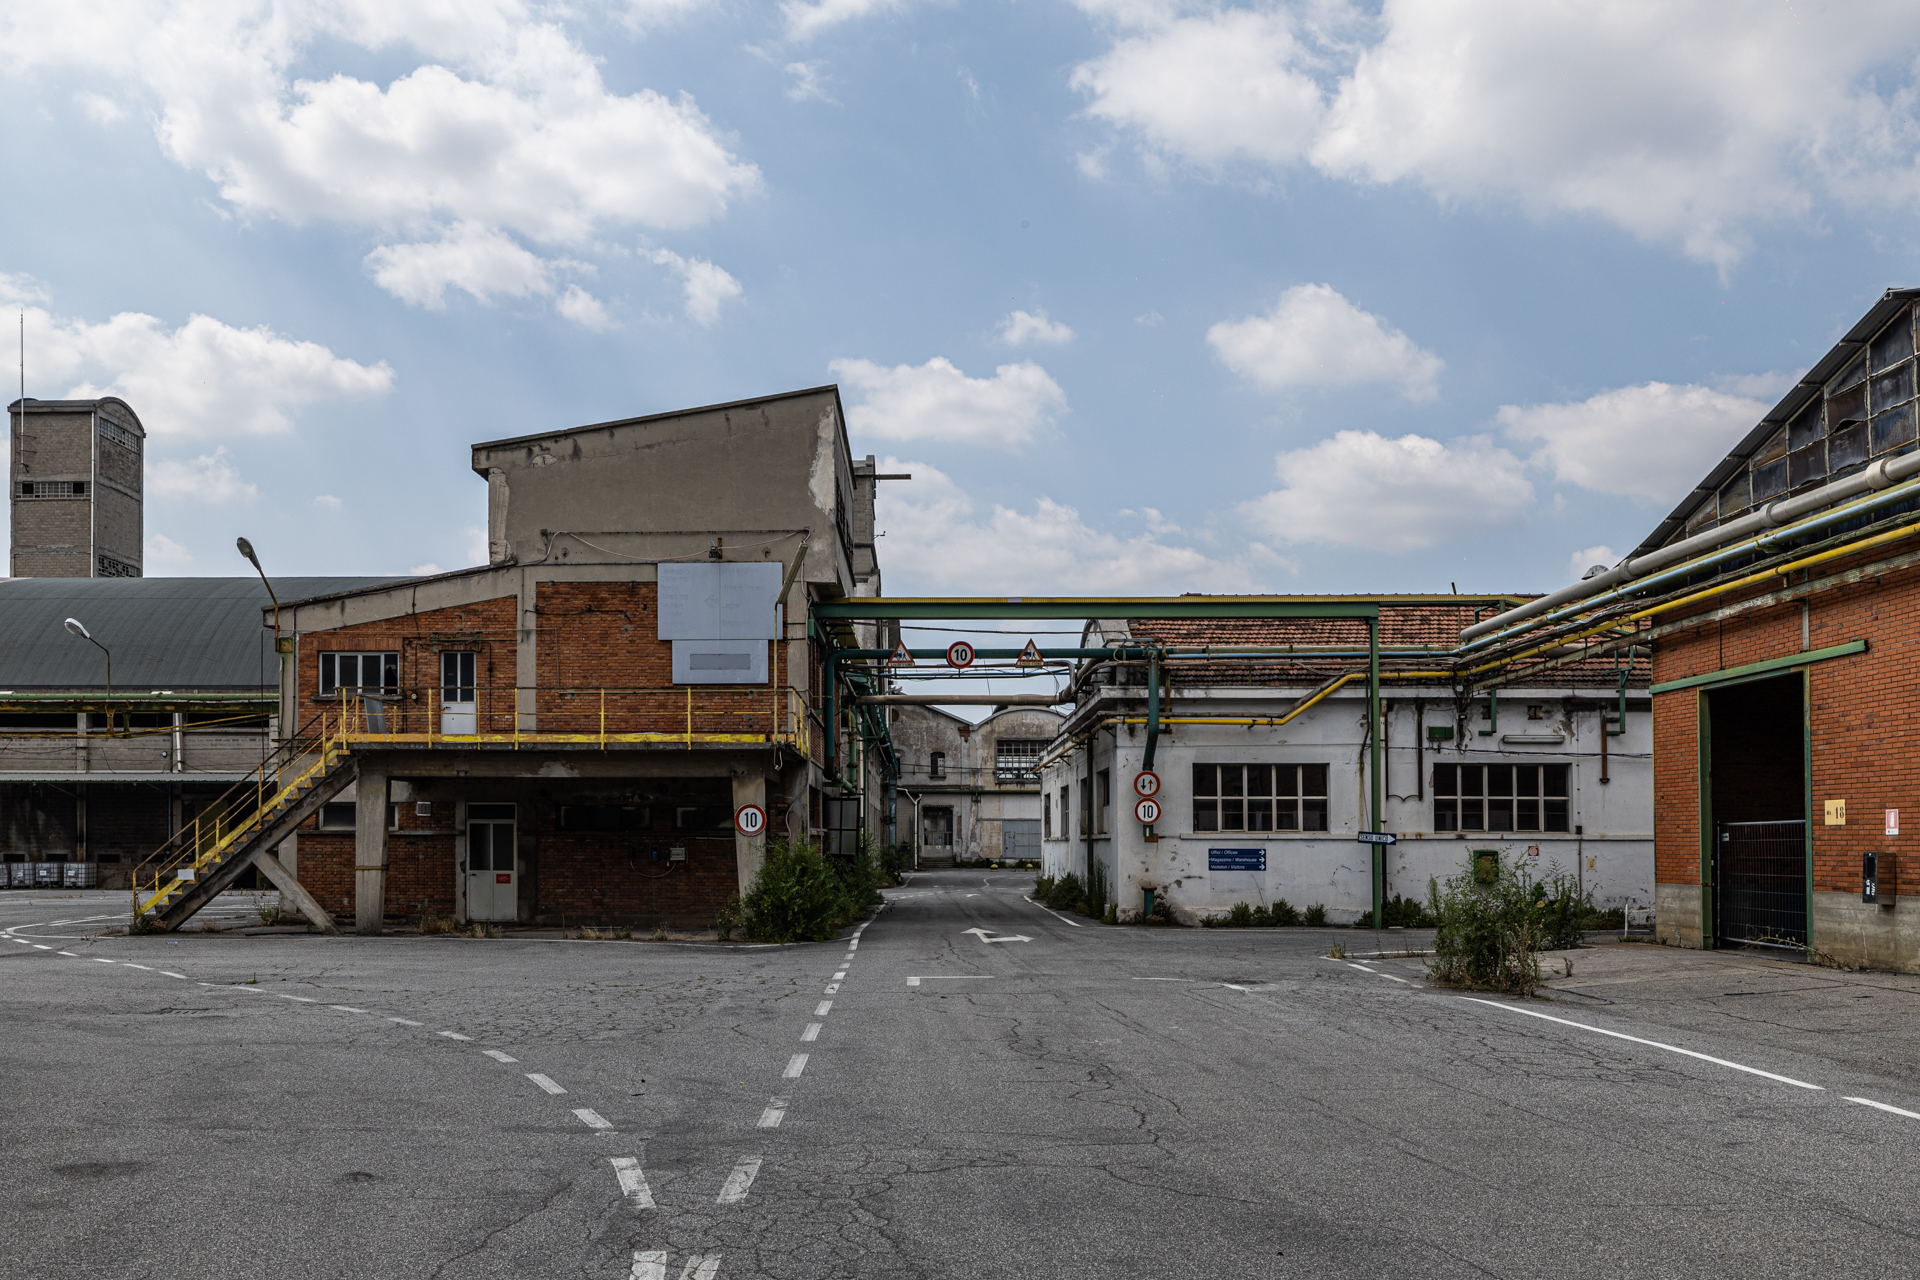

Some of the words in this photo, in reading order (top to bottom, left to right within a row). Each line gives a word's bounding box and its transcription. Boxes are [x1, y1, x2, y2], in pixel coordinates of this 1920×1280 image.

[954, 648, 967, 661] 10
[1142, 804, 1153, 818] 10
[1835, 806, 1844, 819] 18
[744, 812, 757, 828] 10
[1359, 833, 1373, 841] SENSO
[1375, 834, 1388, 842] UNICO
